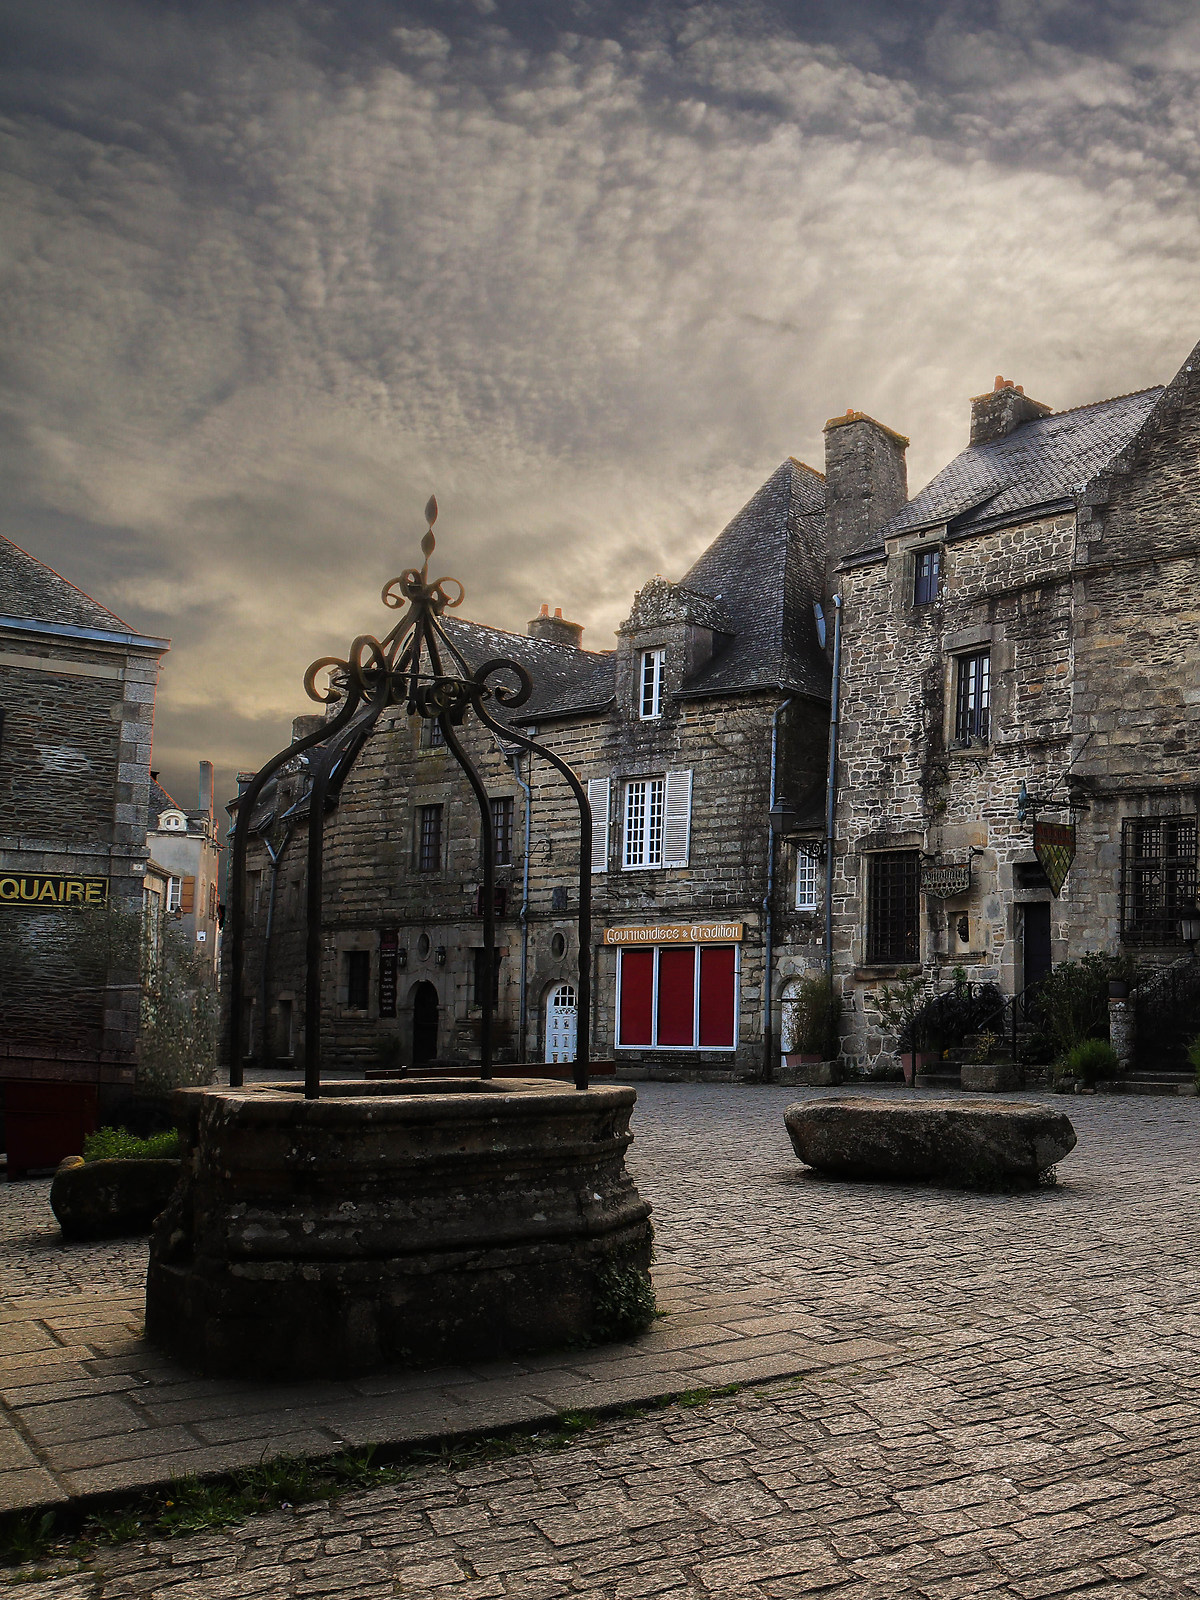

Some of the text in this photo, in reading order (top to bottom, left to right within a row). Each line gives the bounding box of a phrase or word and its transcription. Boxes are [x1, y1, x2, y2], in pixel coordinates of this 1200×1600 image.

[0, 878, 103, 903] QUAIRE
[606, 927, 680, 944] Gourmandises
[690, 924, 739, 941] Tradition
